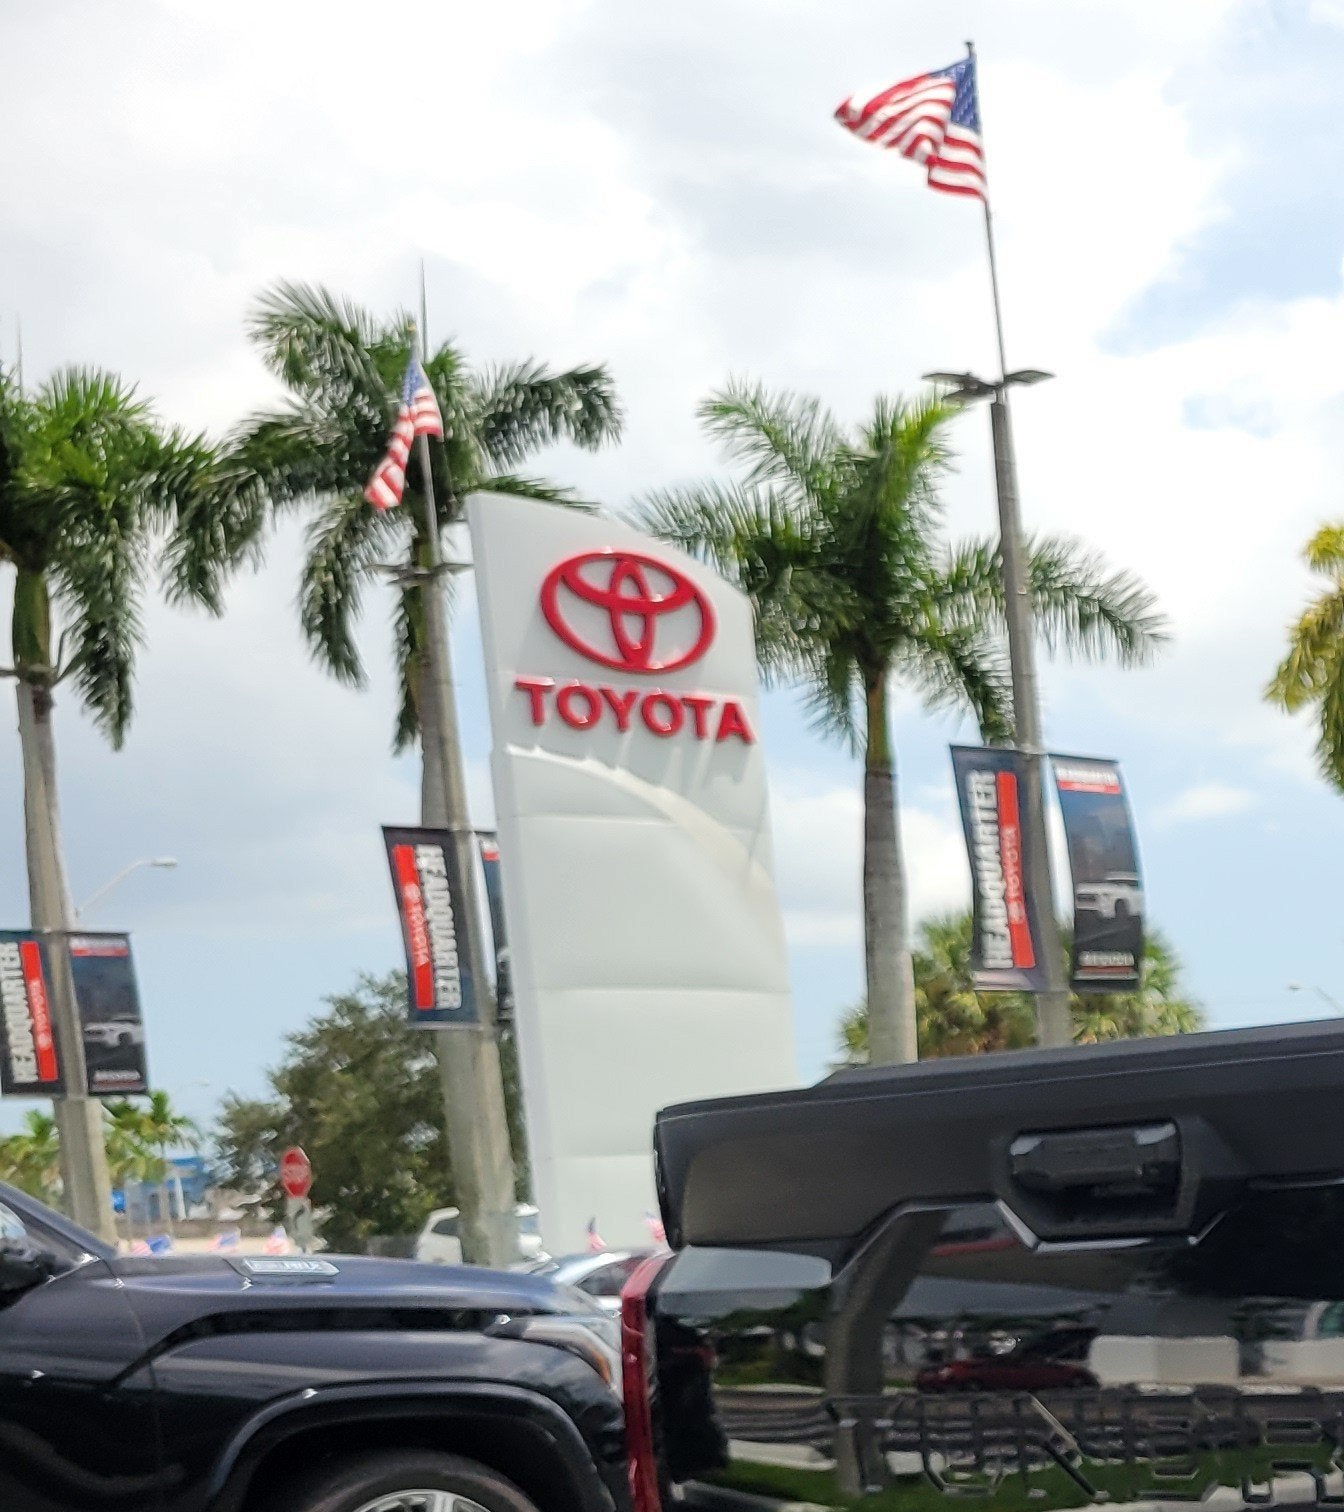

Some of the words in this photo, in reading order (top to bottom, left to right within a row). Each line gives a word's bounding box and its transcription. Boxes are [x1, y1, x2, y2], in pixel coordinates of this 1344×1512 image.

[514, 676, 756, 744] TOYOTA
[416, 844, 462, 1010] HEADQUARTER
[966, 769, 1014, 968] HEADQUARTER
[0, 942, 38, 1082] HEADQUARTER
